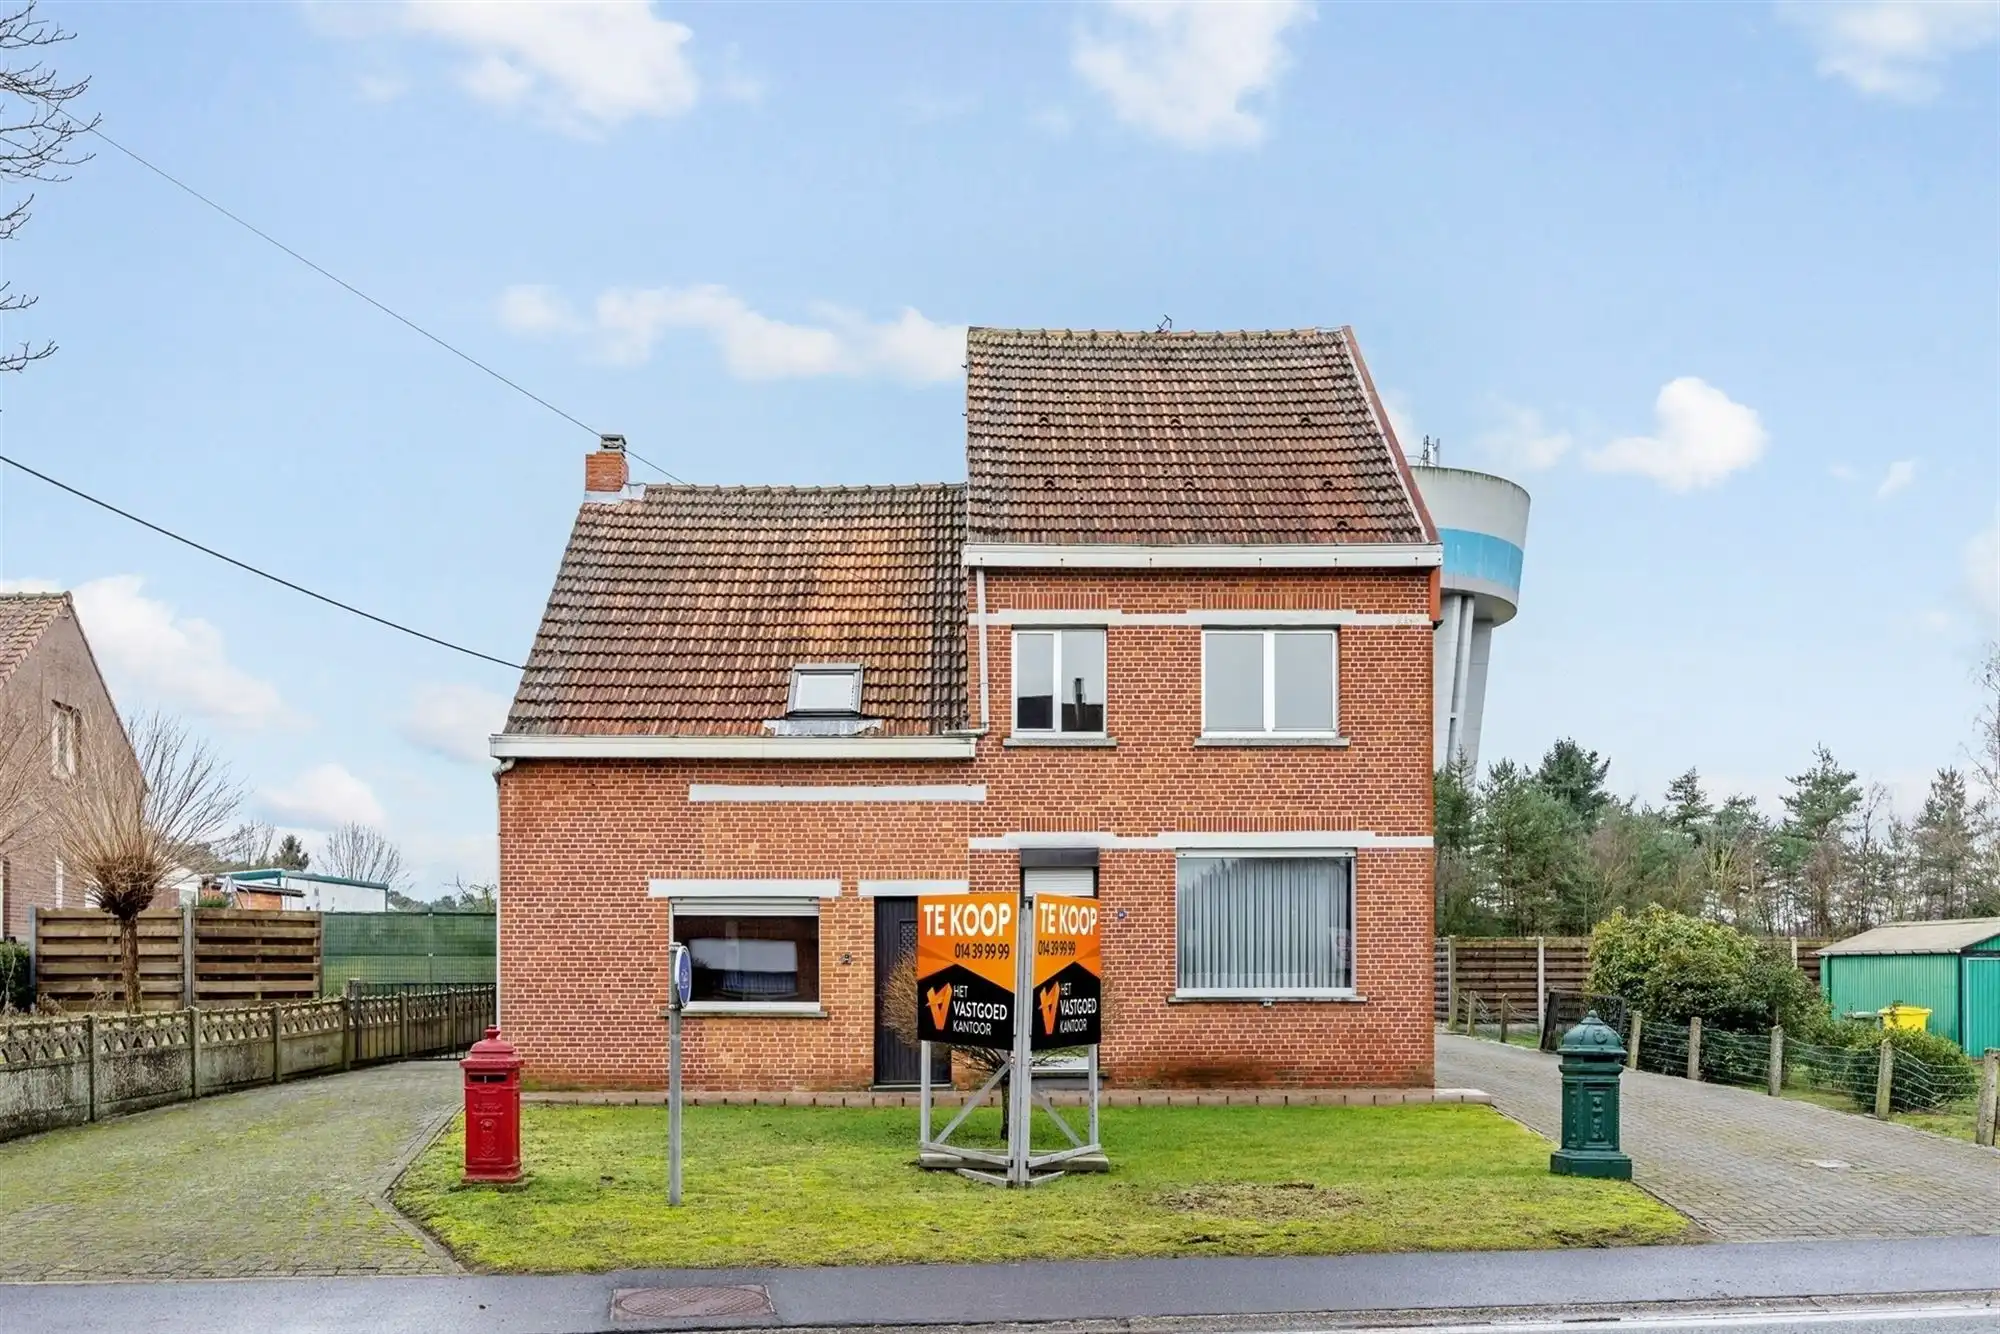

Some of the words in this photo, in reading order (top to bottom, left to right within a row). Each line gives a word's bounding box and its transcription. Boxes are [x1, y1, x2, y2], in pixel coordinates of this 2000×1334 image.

[924, 904, 945, 936] TE
[950, 903, 1011, 936] KOOP
[1040, 903, 1056, 935] TE
[1059, 904, 1098, 936] KOOP
[955, 942, 970, 958] 014
[972, 943, 983, 958] 39
[985, 943, 996, 960] 99
[998, 944, 1010, 960] 99
[1038, 940, 1050, 956] 014
[1050, 941, 1058, 955] 39
[1059, 941, 1067, 955] 99
[1067, 941, 1076, 955] 99
[954, 985, 968, 998] HET
[1060, 982, 1072, 996] HET
[952, 1001, 1008, 1020] VASTGOED
[1060, 998, 1096, 1016] VASTGOED
[952, 1020, 992, 1036] KANTOOR
[1060, 1018, 1088, 1034] KANTOOR
